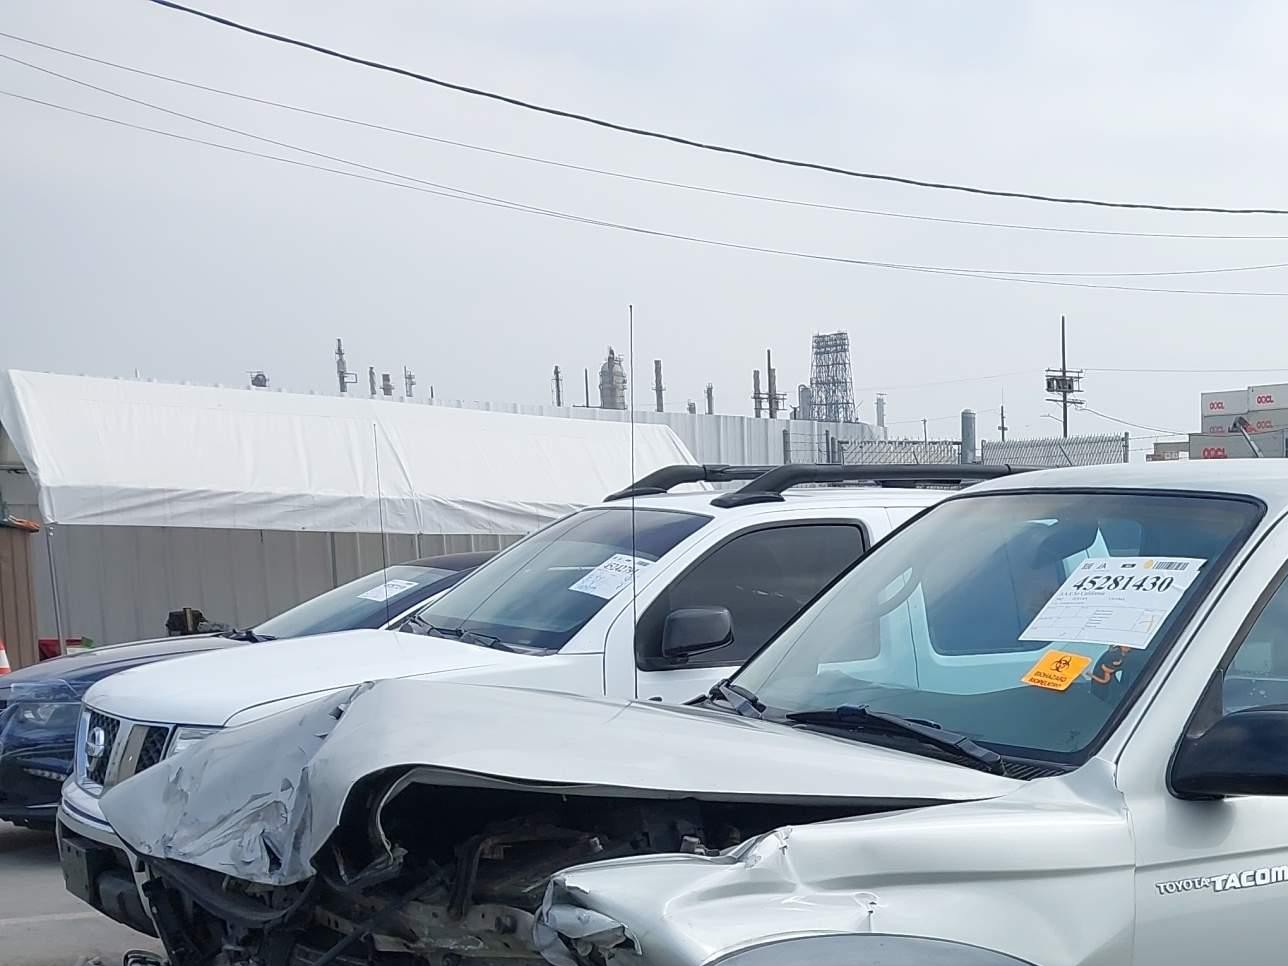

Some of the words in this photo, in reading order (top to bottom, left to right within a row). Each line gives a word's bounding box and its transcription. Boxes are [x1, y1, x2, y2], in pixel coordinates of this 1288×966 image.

[1256, 394, 1274, 404] OOCL
[1072, 575, 1175, 593] 45281430
[1156, 877, 1210, 895] TOYOTA
